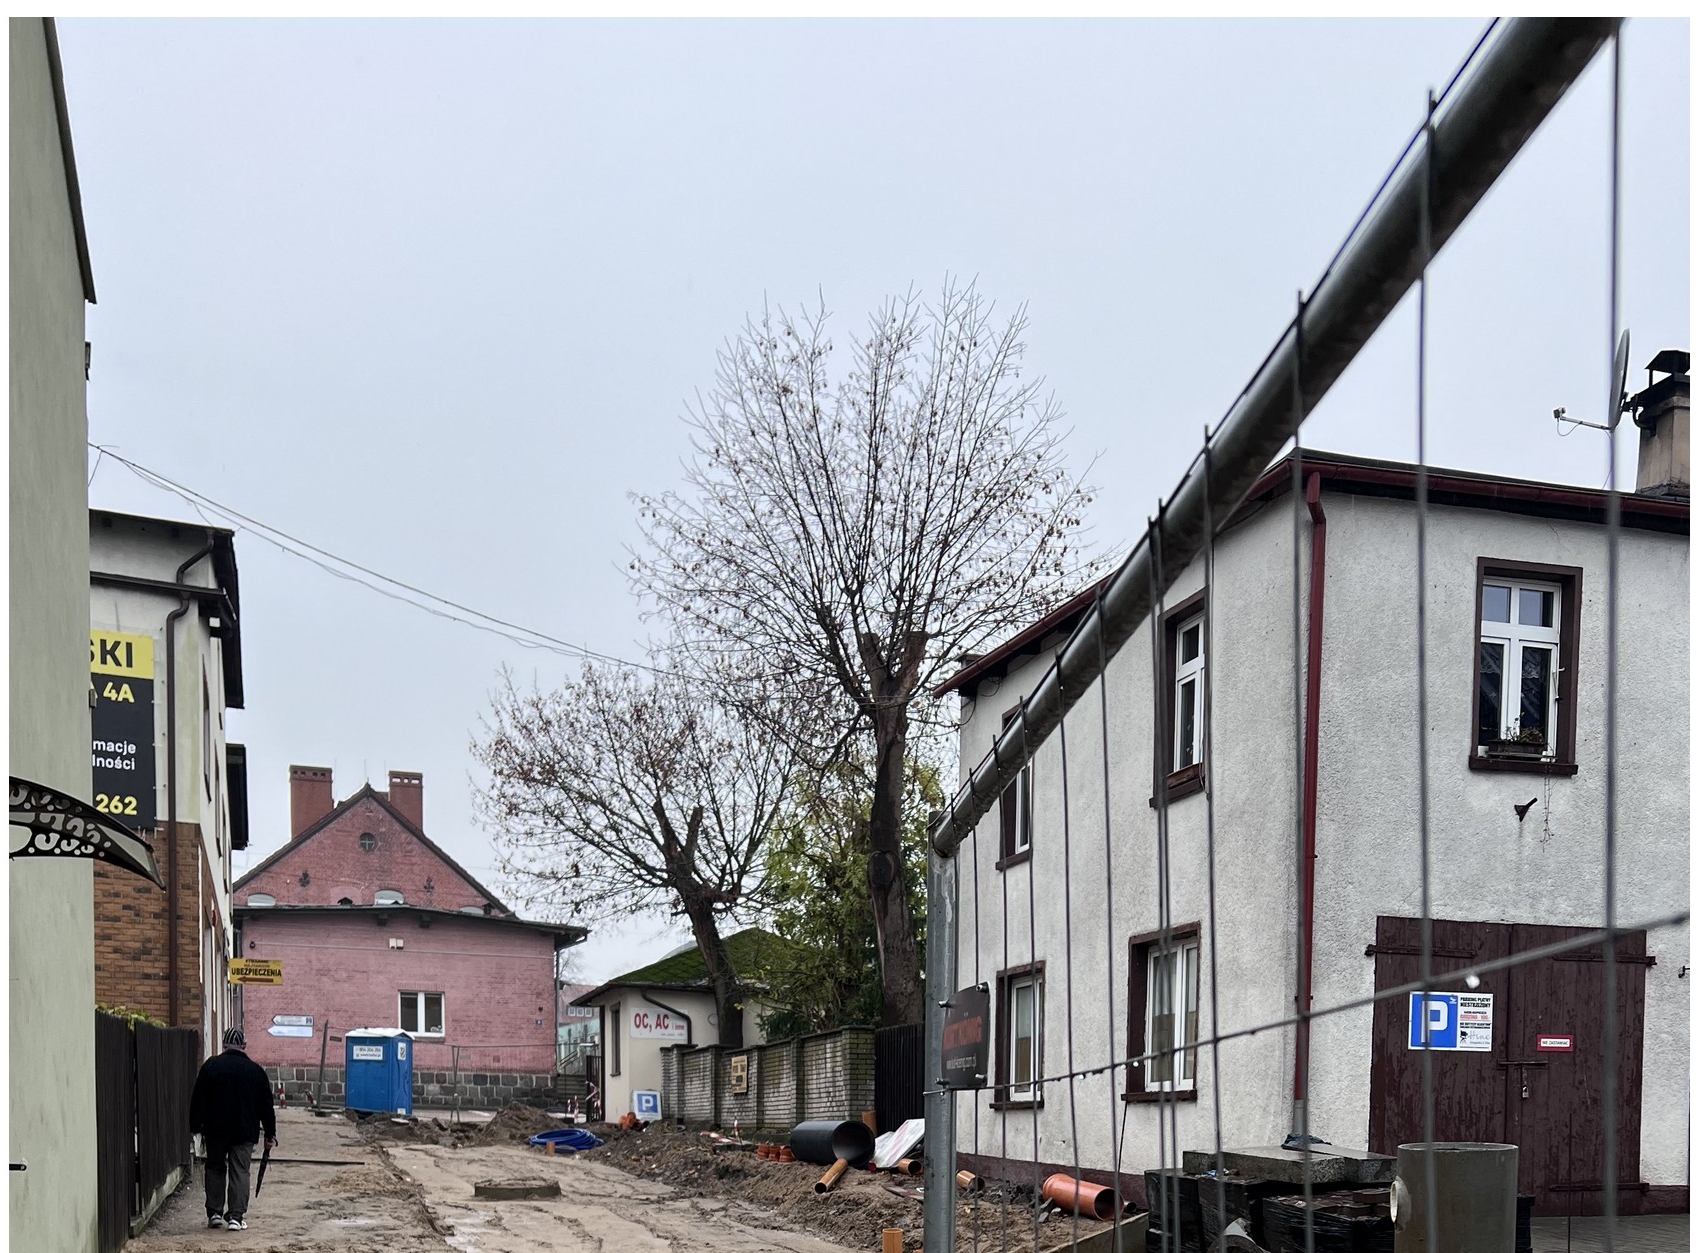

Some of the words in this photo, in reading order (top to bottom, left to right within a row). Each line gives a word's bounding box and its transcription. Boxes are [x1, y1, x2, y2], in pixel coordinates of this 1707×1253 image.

[102, 681, 135, 703] 4A
[95, 793, 138, 816] 262
[231, 967, 282, 977] UBEZPIECZENIA
[634, 1013, 652, 1032] OC,
[655, 1014, 669, 1030] AC
[641, 1097, 653, 1111] P
